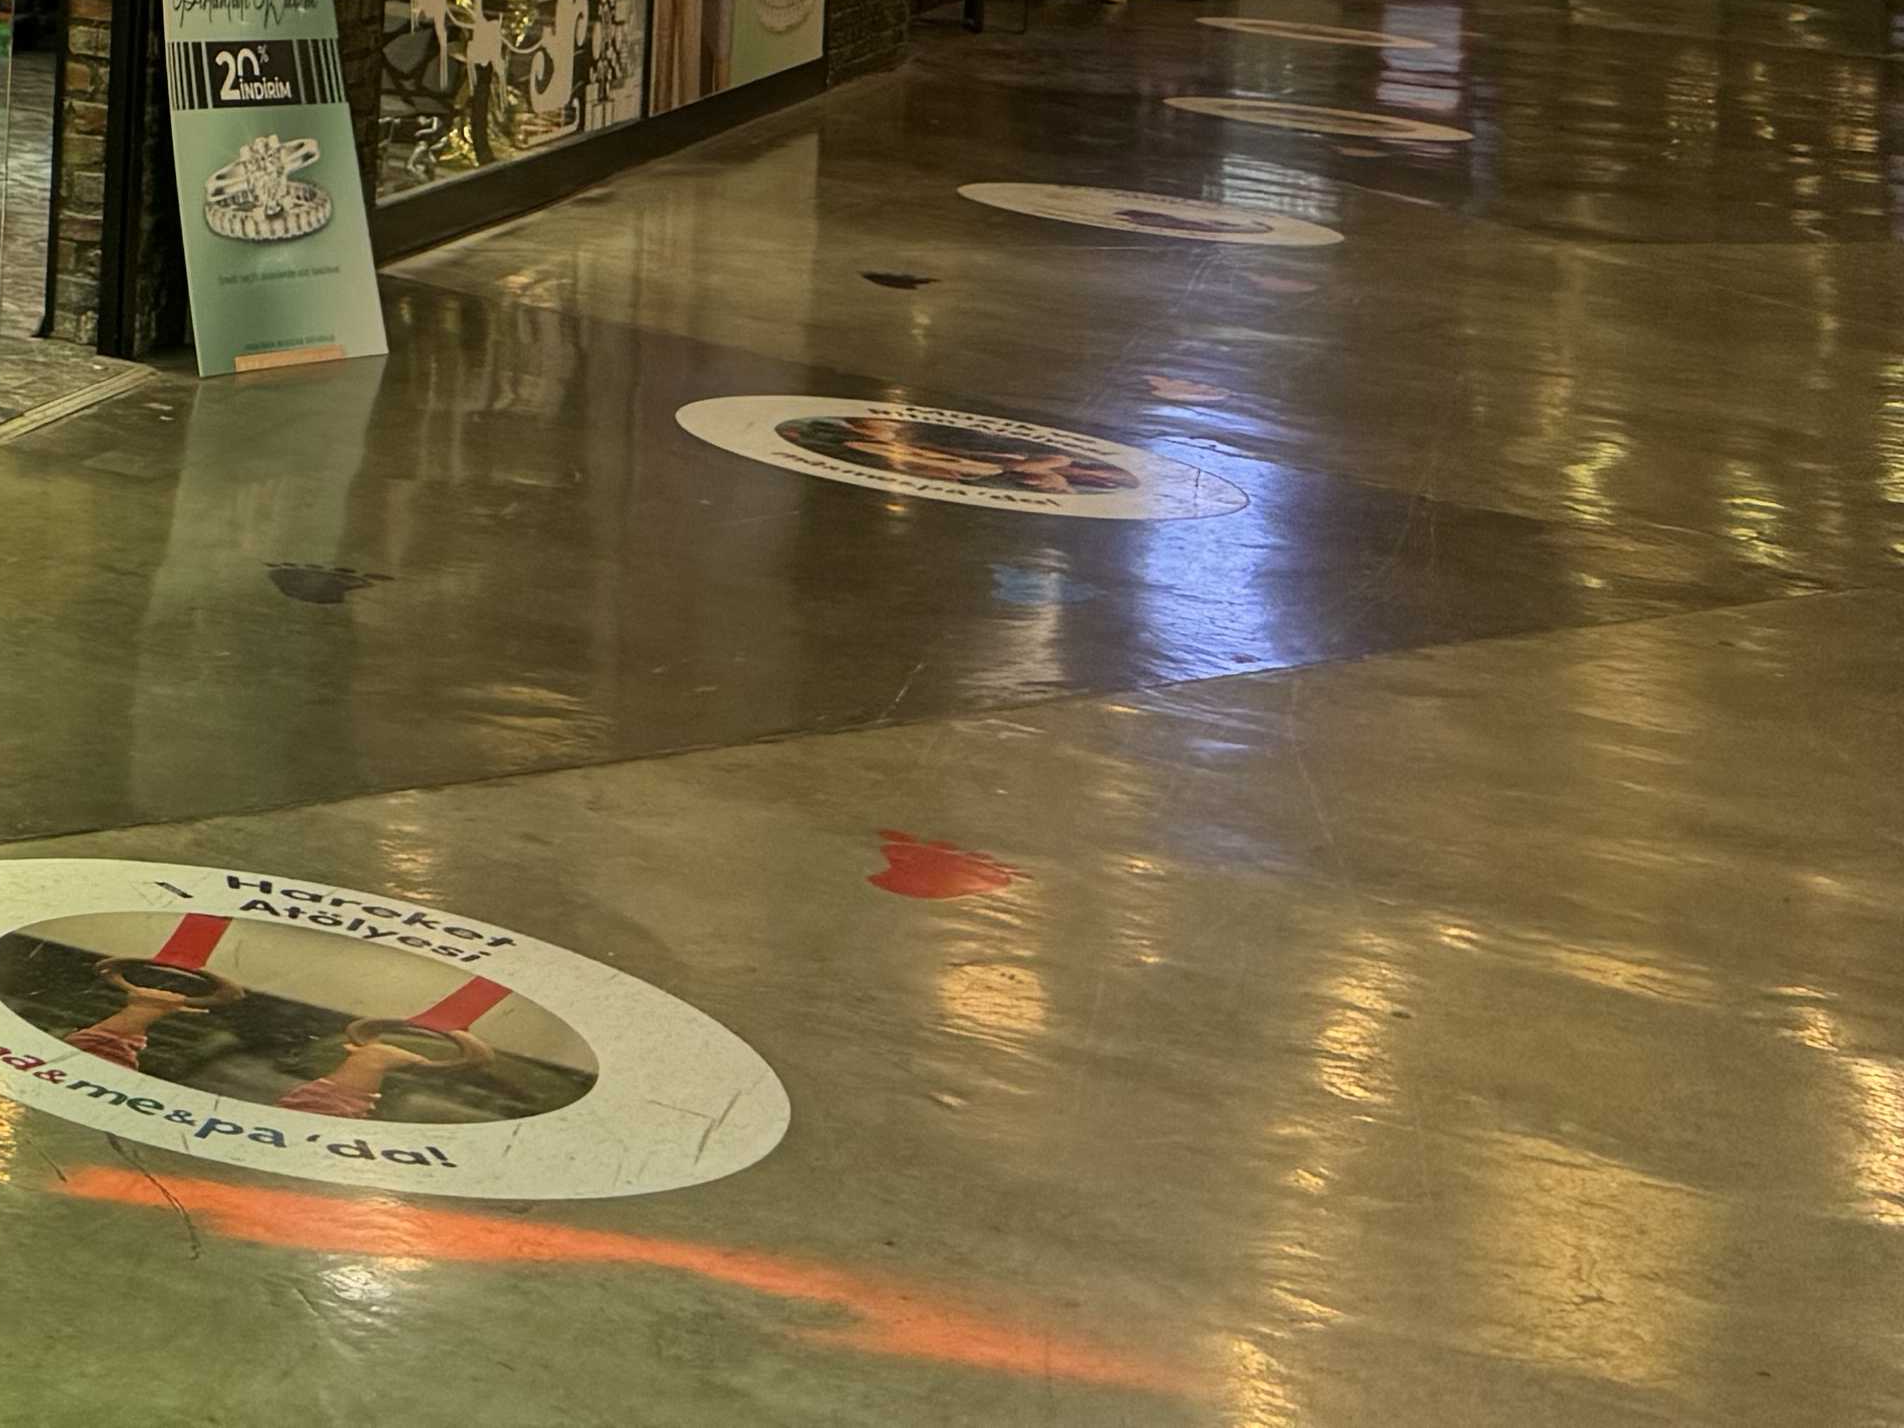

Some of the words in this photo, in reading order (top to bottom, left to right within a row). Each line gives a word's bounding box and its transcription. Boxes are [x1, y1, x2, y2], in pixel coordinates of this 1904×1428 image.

[239, 76, 292, 101] İNDİRİM
[227, 875, 517, 948] Hareket
[240, 899, 492, 963] Atölyesi
